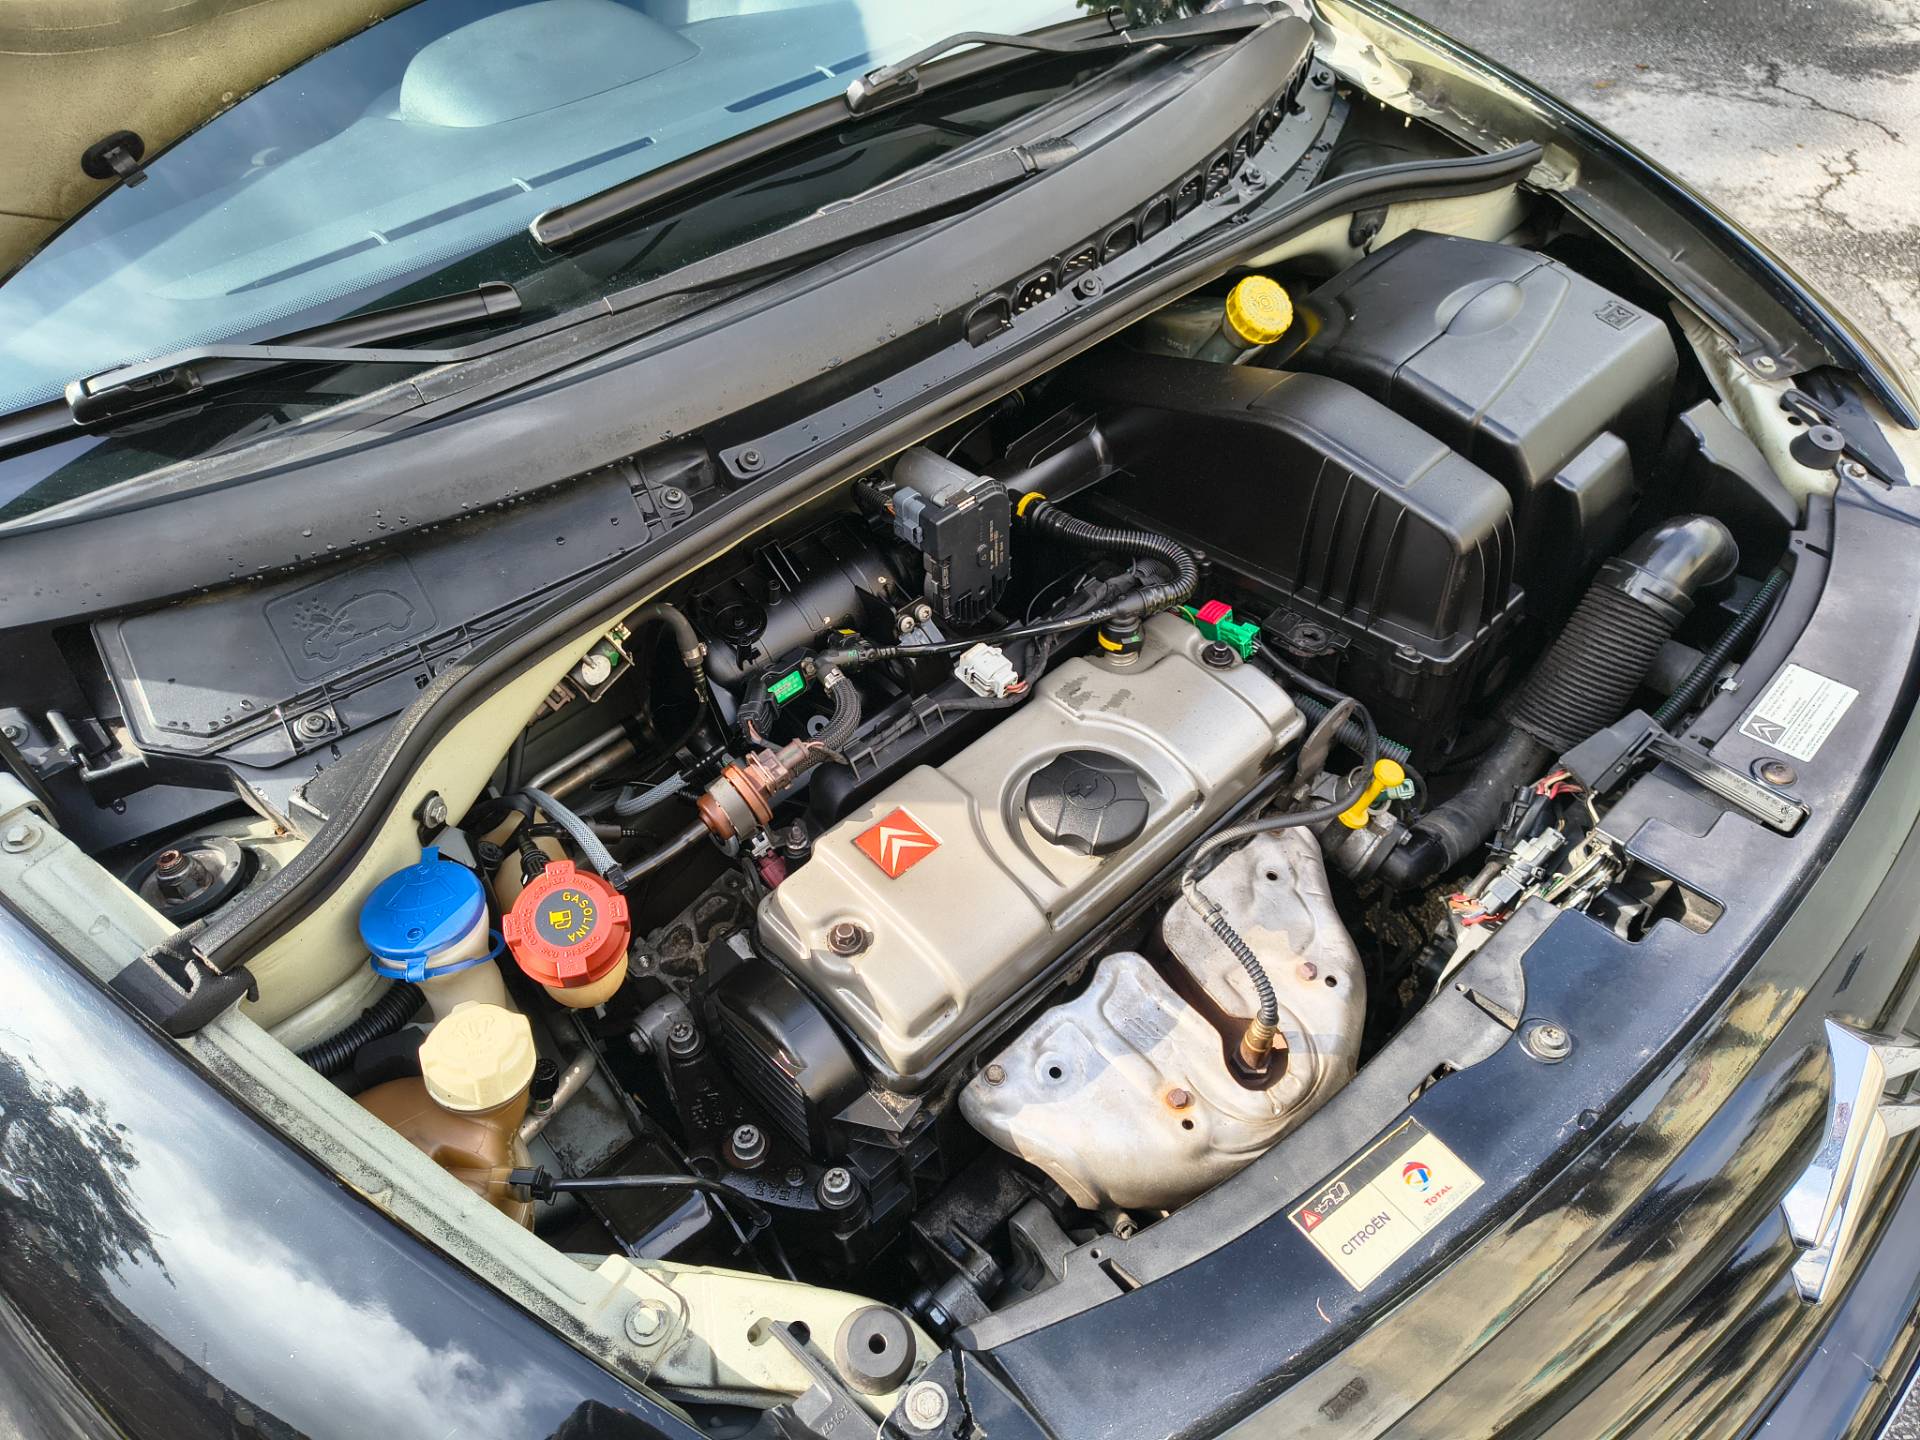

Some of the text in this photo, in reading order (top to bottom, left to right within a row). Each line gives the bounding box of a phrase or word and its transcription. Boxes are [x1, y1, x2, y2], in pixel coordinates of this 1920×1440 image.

[562, 891, 593, 942] GASOLINA
[1423, 1184, 1453, 1207] TOTAL
[1340, 1211, 1392, 1256] CITROËN
